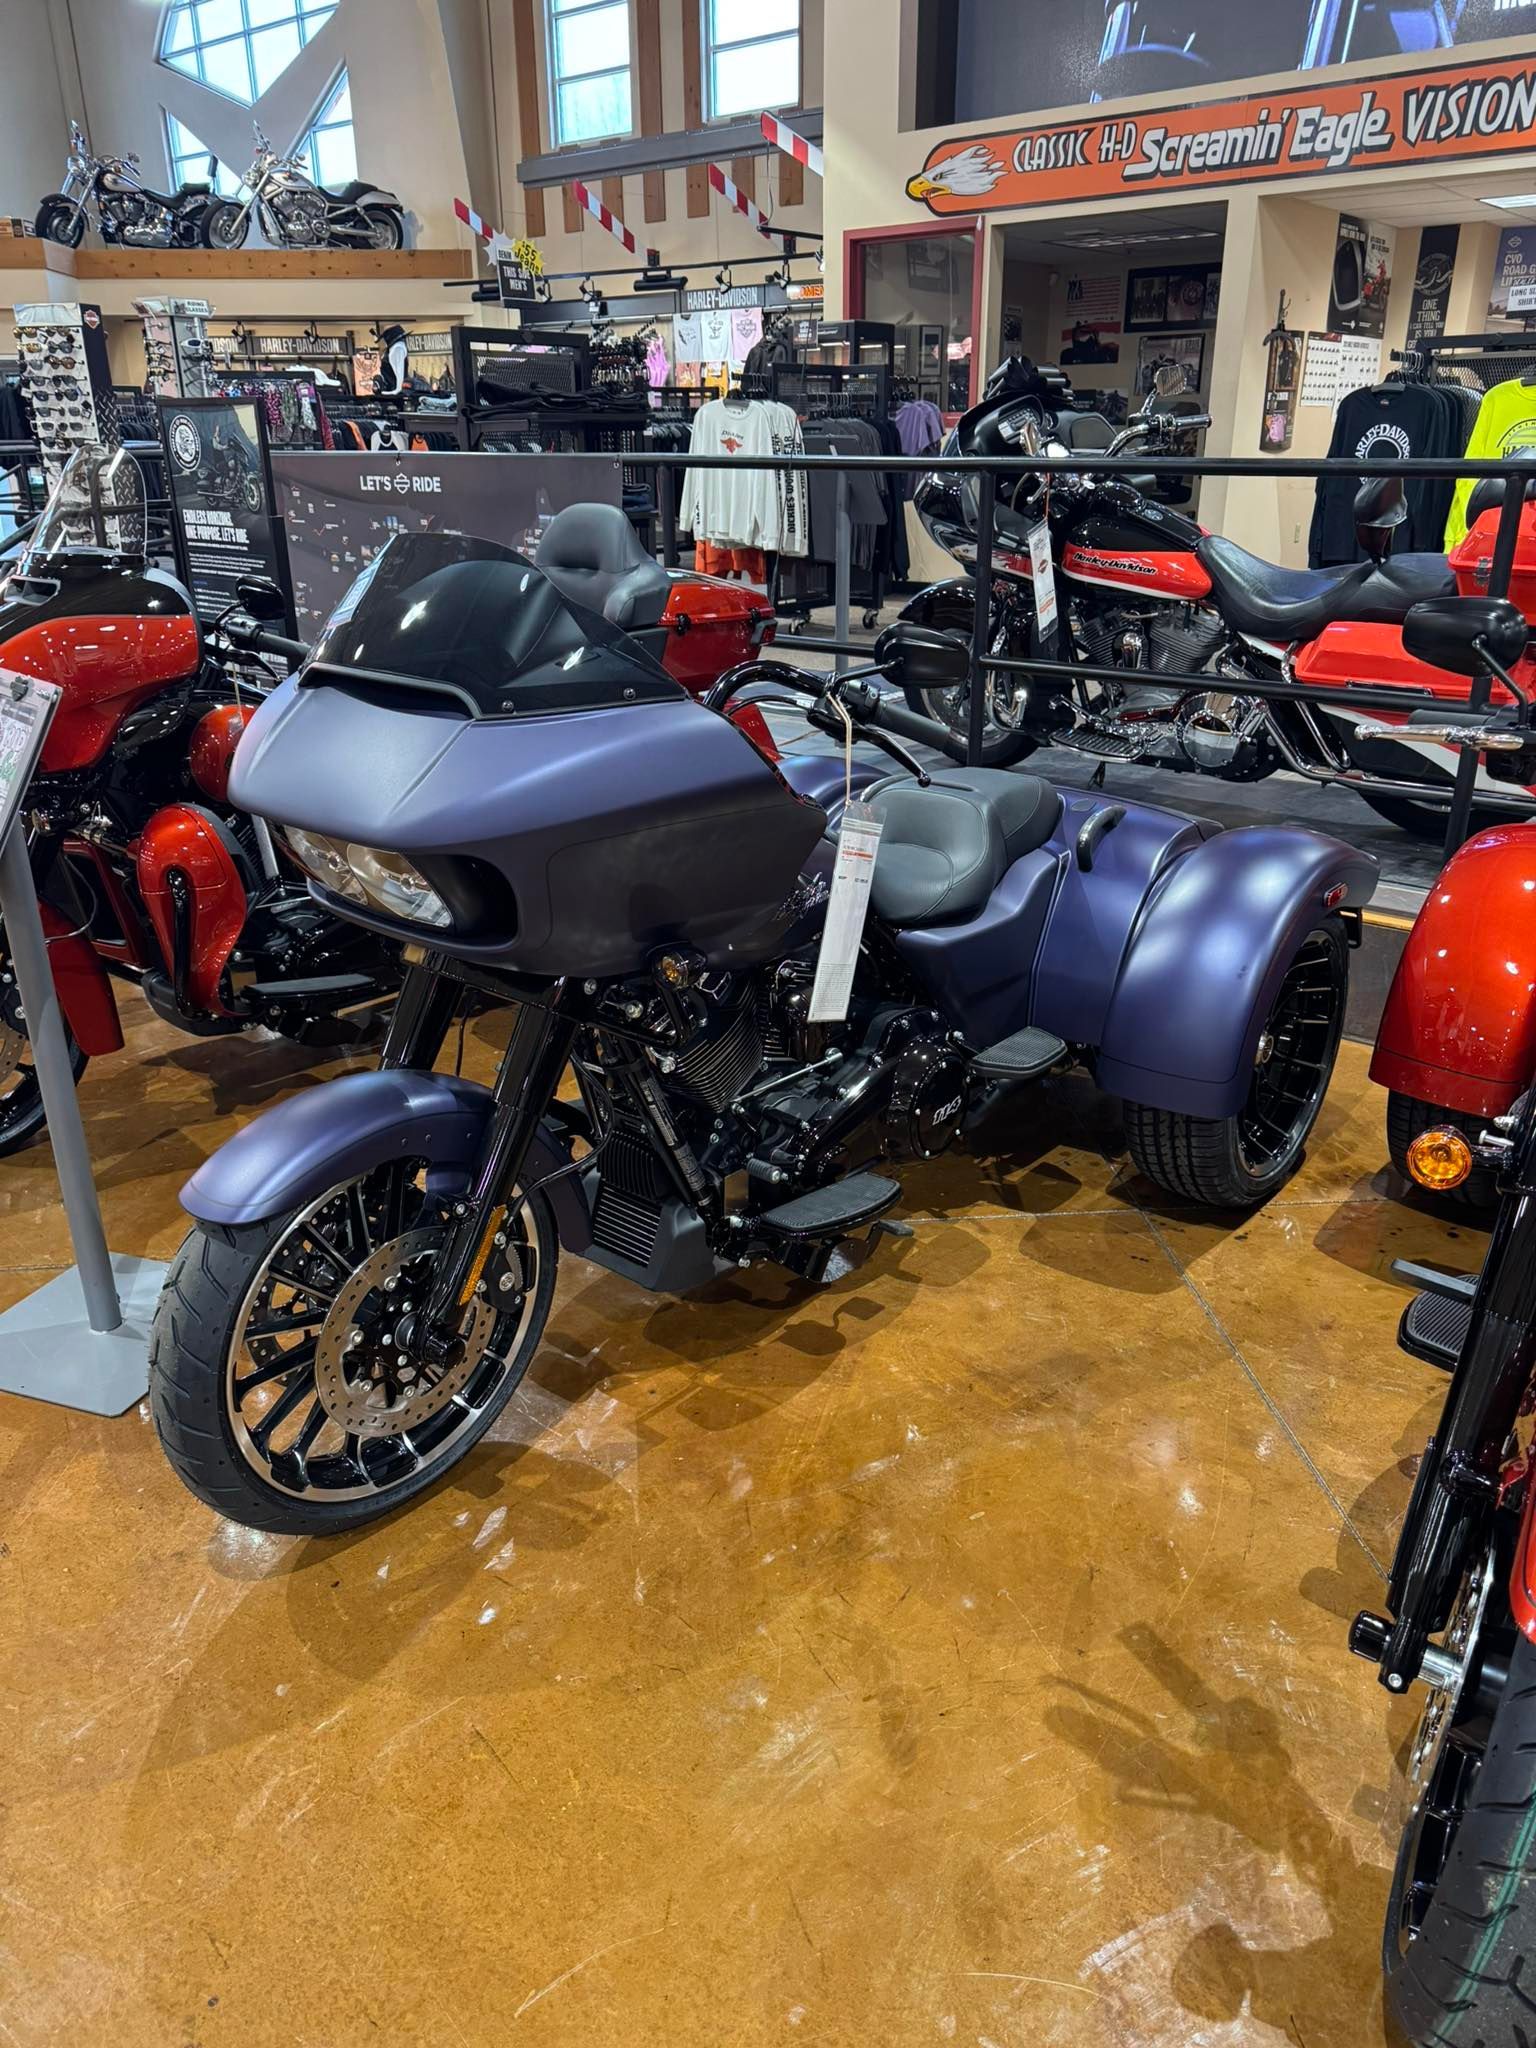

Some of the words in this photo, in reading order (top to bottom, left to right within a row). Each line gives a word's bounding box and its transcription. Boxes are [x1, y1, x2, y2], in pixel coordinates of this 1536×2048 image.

[1012, 127, 1097, 173] CLASSIC
[1099, 121, 1138, 163] H-D
[1121, 108, 1292, 182] Screamin'
[1289, 91, 1395, 168] Eagle
[1402, 72, 1536, 148] VISION
[1505, 253, 1522, 265] CVO
[503, 266, 517, 278] THIS
[1503, 265, 1527, 276] ROAD
[687, 286, 758, 310] HARLEY-DAVIDSON
[1422, 299, 1439, 310] ONE
[1417, 311, 1440, 322] THING
[260, 337, 340, 353] HARLEY-DAVIDSON
[1354, 423, 1411, 459] ARLEY-DAVIDSO
[360, 475, 391, 491] LET'S
[412, 477, 442, 493] RIDE
[786, 496, 796, 533] DICKIES
[1073, 552, 1158, 575] Harley-Davidson
